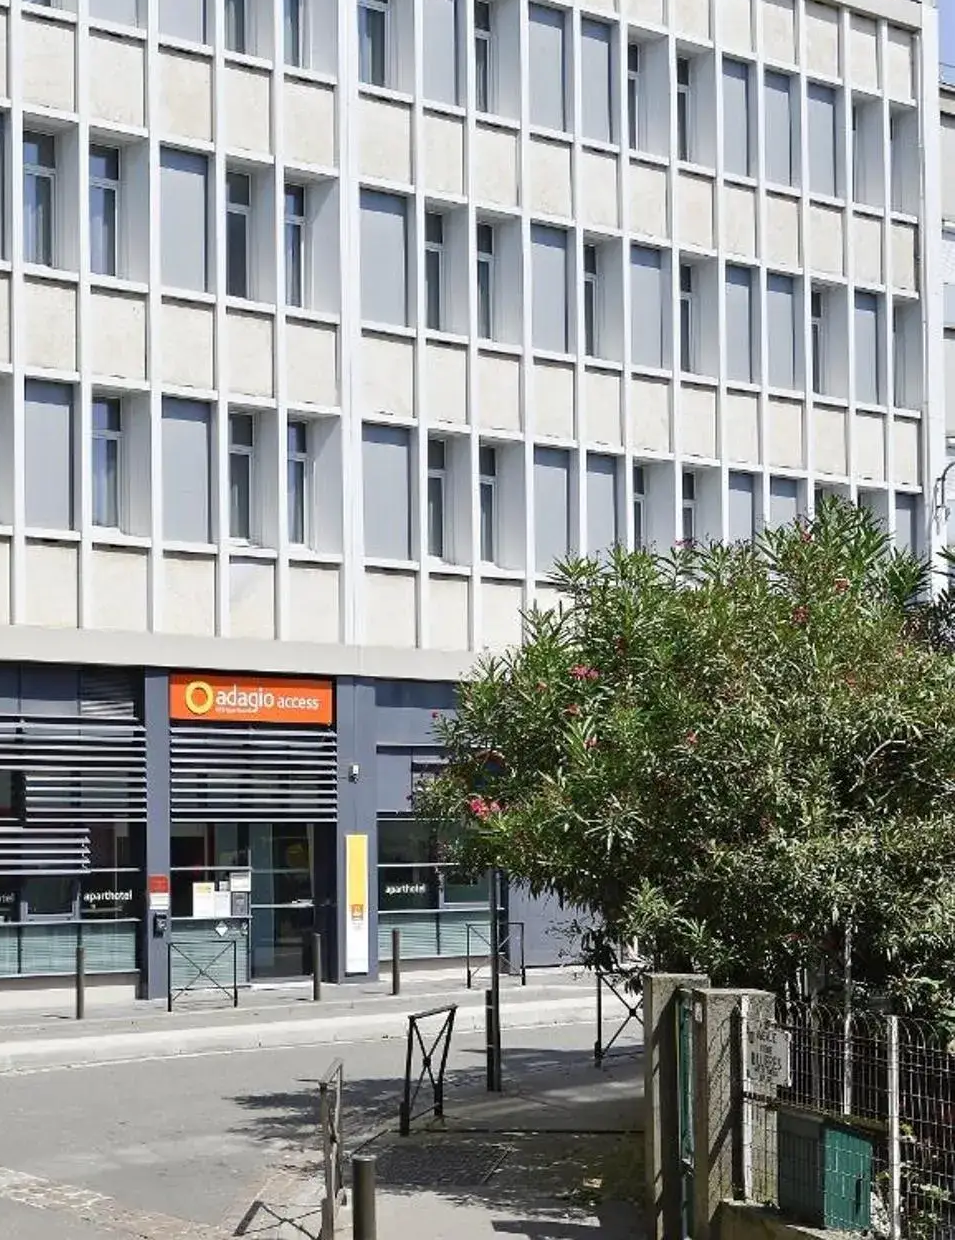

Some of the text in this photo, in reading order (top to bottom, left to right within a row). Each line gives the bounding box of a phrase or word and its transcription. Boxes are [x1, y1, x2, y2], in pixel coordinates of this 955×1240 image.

[215, 684, 320, 713] adagio access
[83, 889, 133, 904] aparthotel
[385, 883, 426, 895] aparthotel
